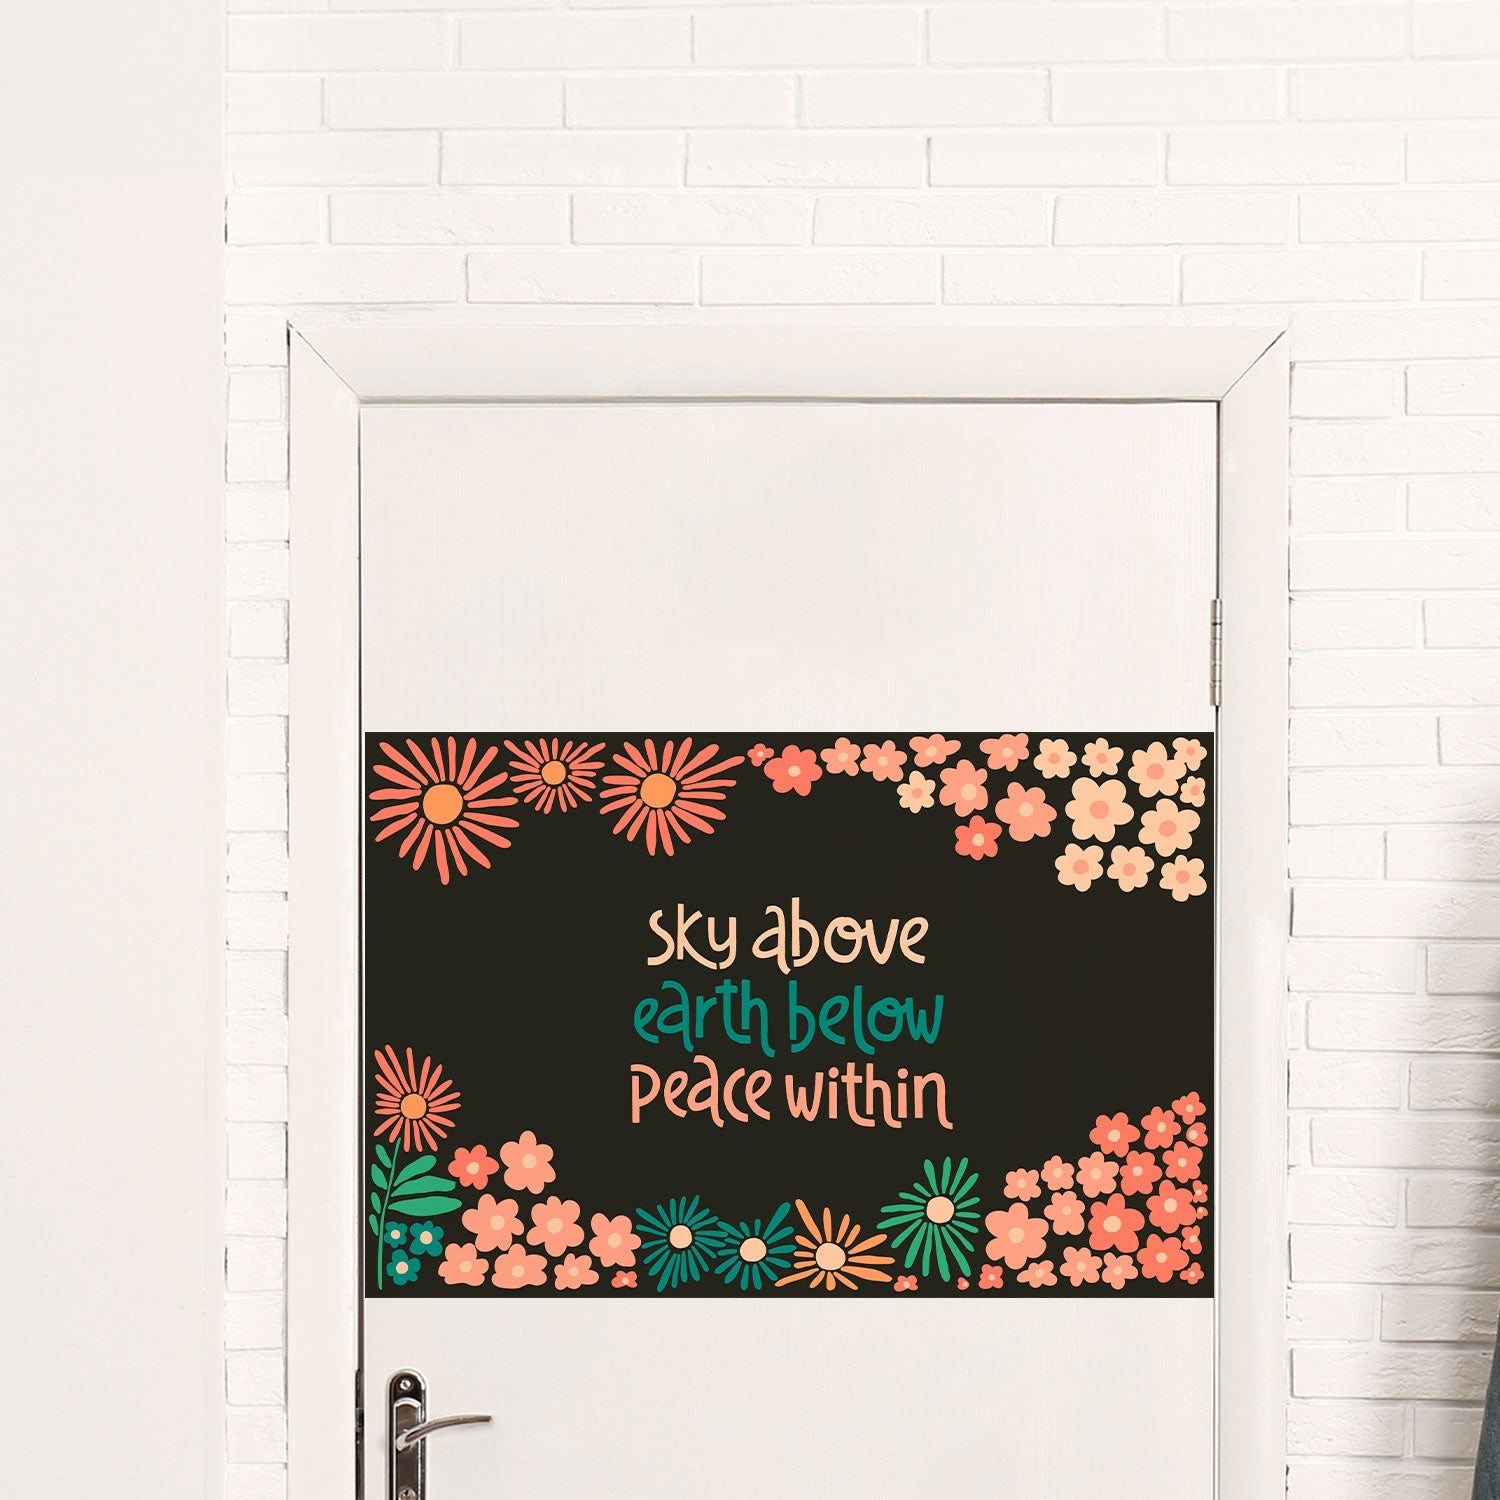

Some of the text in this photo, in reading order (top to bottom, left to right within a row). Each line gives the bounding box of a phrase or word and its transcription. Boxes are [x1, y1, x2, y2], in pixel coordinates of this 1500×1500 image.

[646, 896, 930, 976] sky above
[633, 978, 945, 1059] earth below
[629, 1054, 954, 1131] peace within
